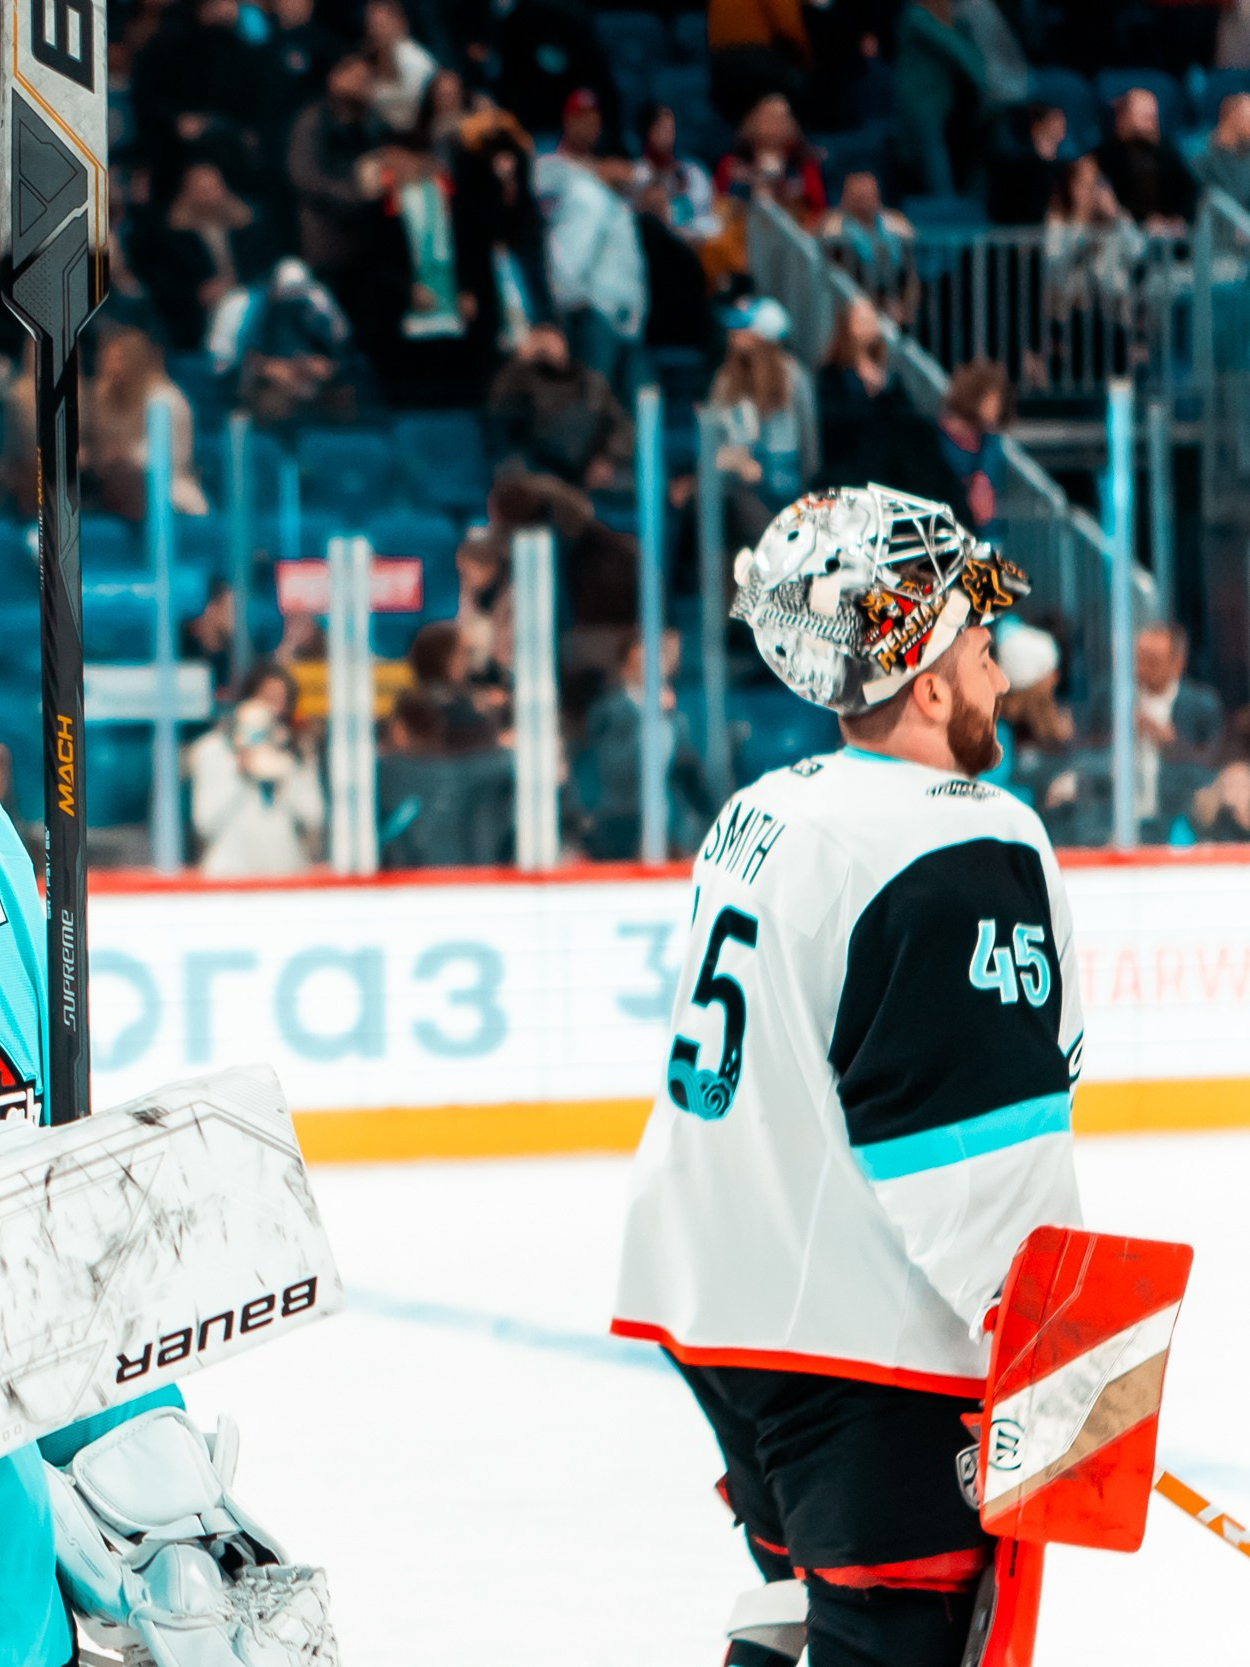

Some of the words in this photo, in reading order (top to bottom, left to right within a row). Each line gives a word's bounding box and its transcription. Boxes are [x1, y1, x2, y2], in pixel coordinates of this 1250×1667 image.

[57, 714, 75, 817] MACH
[62, 909, 77, 1032] SUPREME
[666, 885, 759, 1121] 5
[969, 918, 1051, 1008] 45
